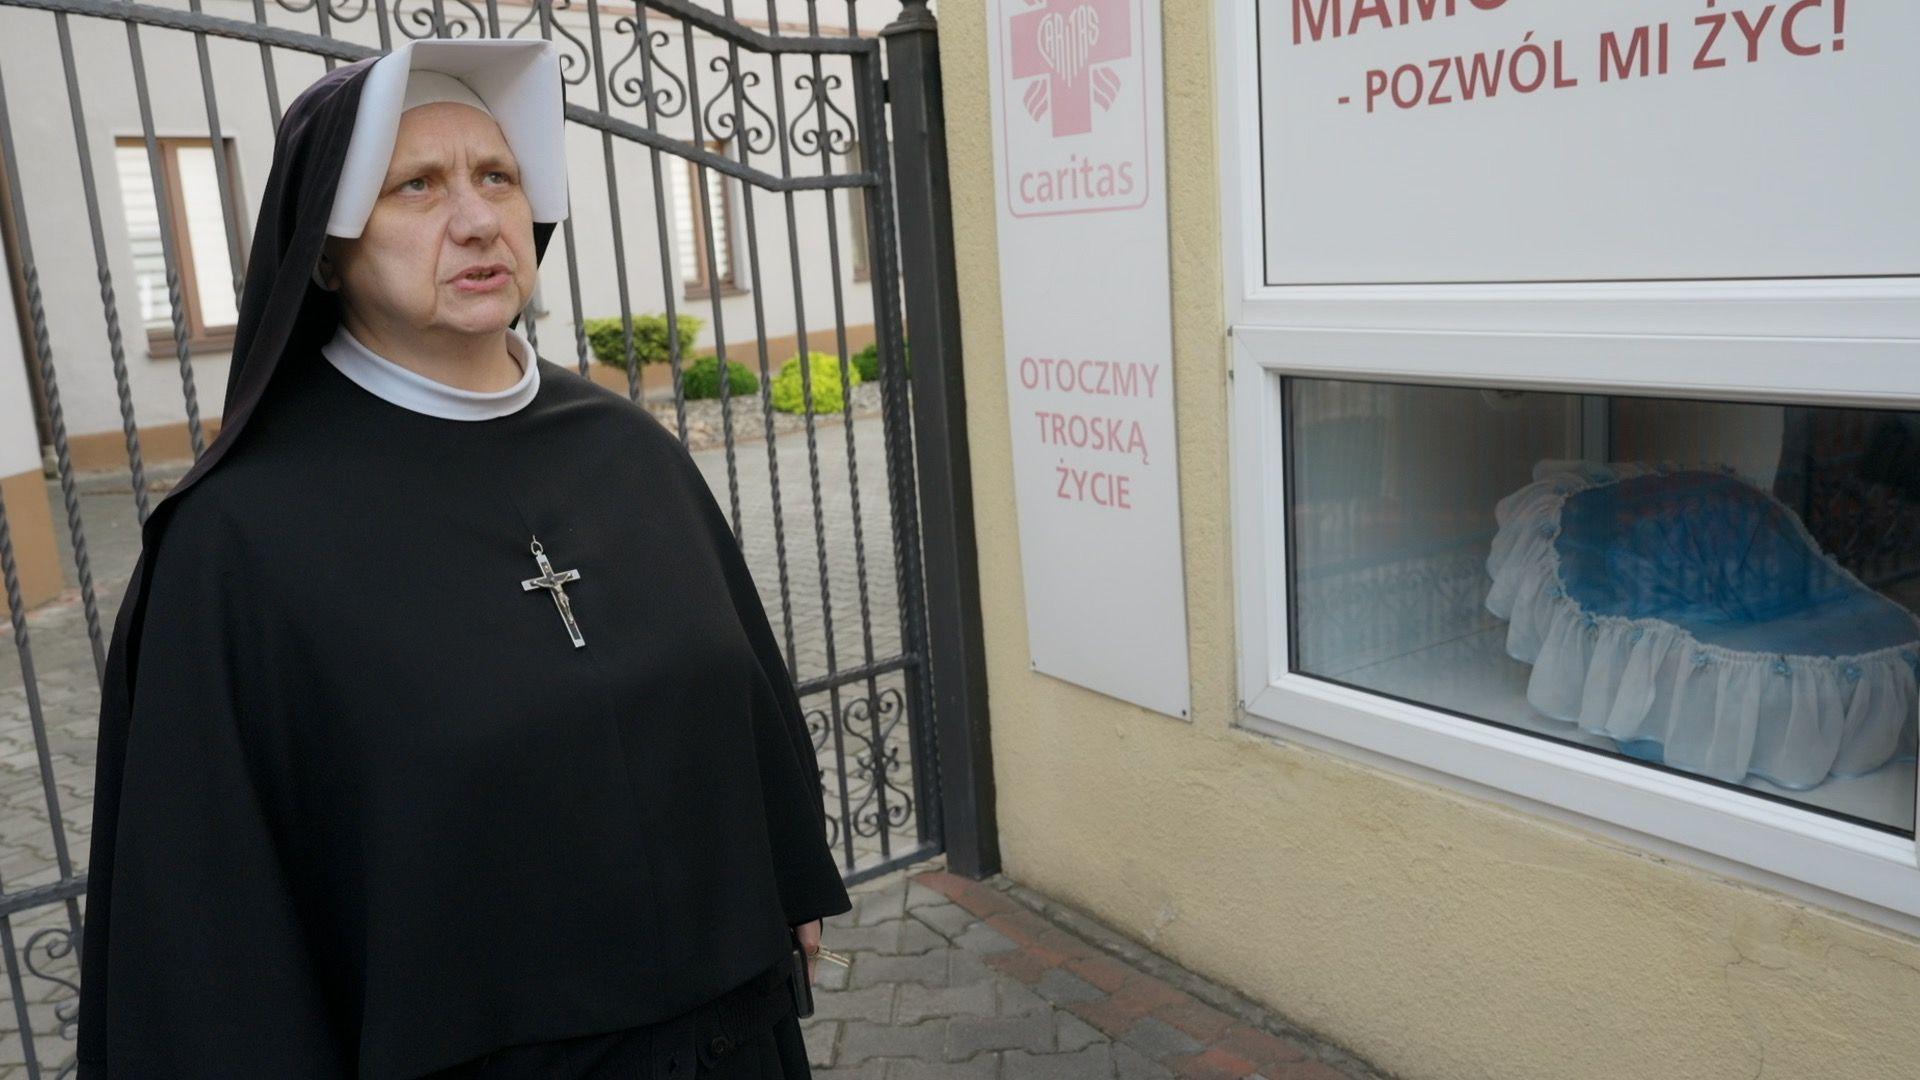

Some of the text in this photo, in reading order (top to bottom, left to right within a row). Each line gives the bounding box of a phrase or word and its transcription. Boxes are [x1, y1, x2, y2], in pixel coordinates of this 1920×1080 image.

[1366, 31, 1578, 113] POZWÓL
[1600, 22, 1668, 82] MI
[1019, 153, 1134, 204] caritas
[1020, 357, 1159, 398] OTOCZMY
[1035, 411, 1149, 465] TROSKĄ
[1056, 458, 1131, 509] ŻYCIE
